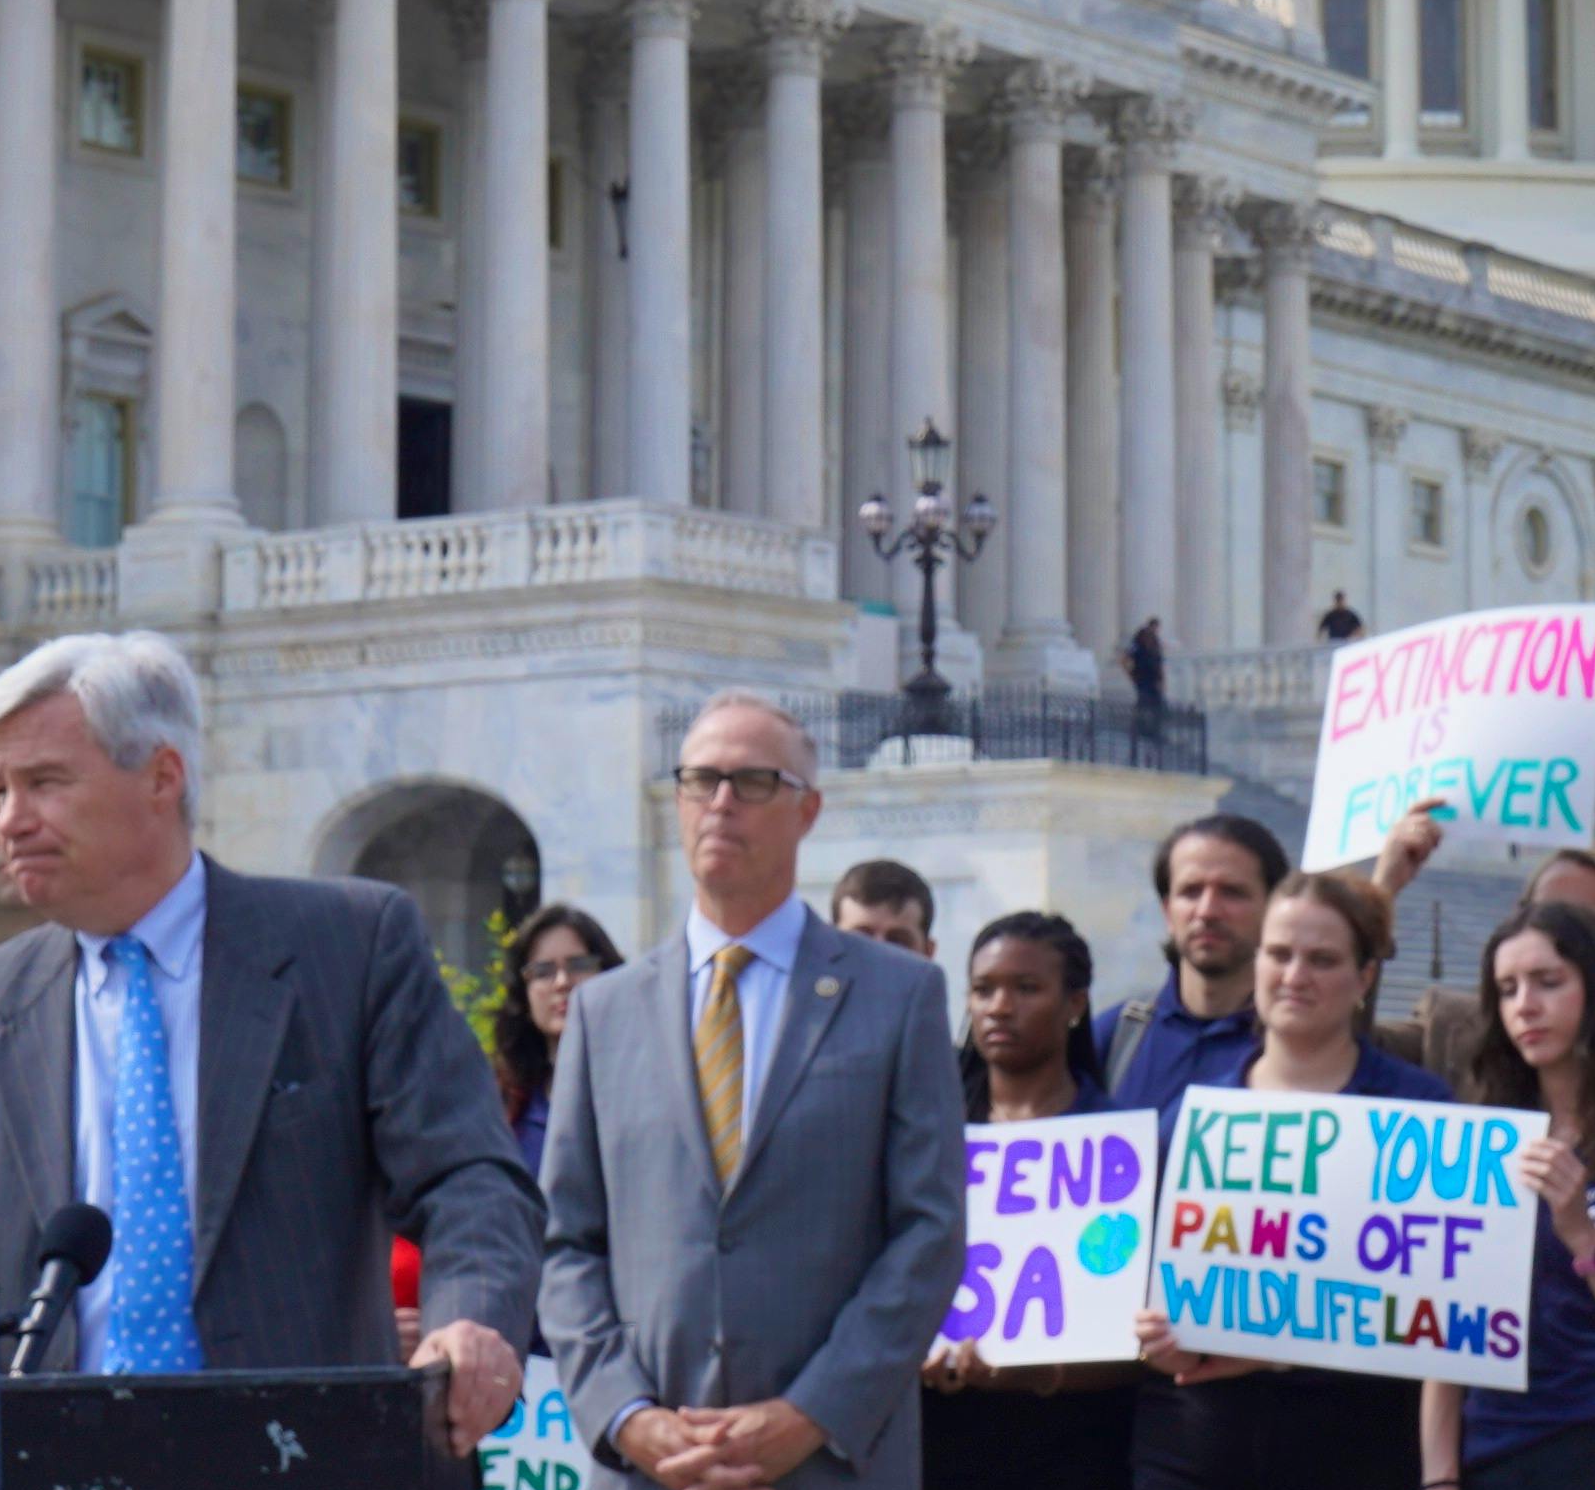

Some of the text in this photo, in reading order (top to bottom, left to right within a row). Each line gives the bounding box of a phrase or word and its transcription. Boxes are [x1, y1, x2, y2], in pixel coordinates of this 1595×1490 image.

[1409, 705, 1450, 760] IS
[965, 1134, 1141, 1215] FEND
[1177, 1107, 1519, 1208] KEEP YOUR
[1170, 1201, 1485, 1280] PAWS OFF
[939, 1242, 1064, 1343] SA
